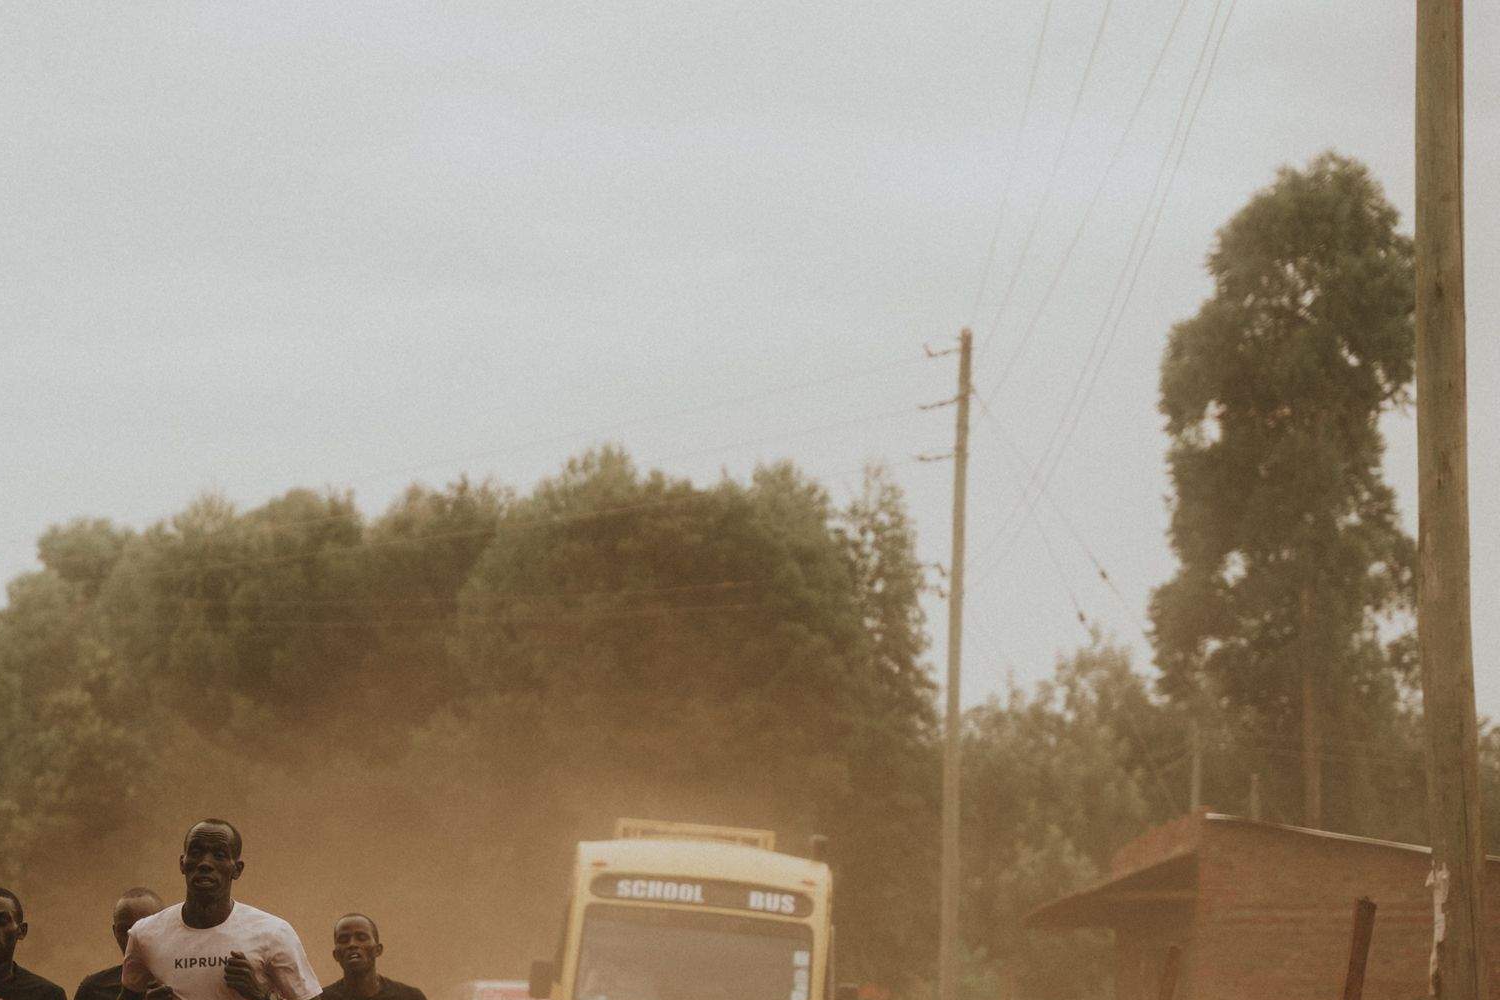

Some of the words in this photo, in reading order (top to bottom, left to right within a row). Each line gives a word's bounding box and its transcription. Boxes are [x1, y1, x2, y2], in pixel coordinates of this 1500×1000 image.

[616, 879, 705, 904] SCHOOL
[748, 891, 796, 914] BUS
[174, 956, 228, 969] KIPRUN
